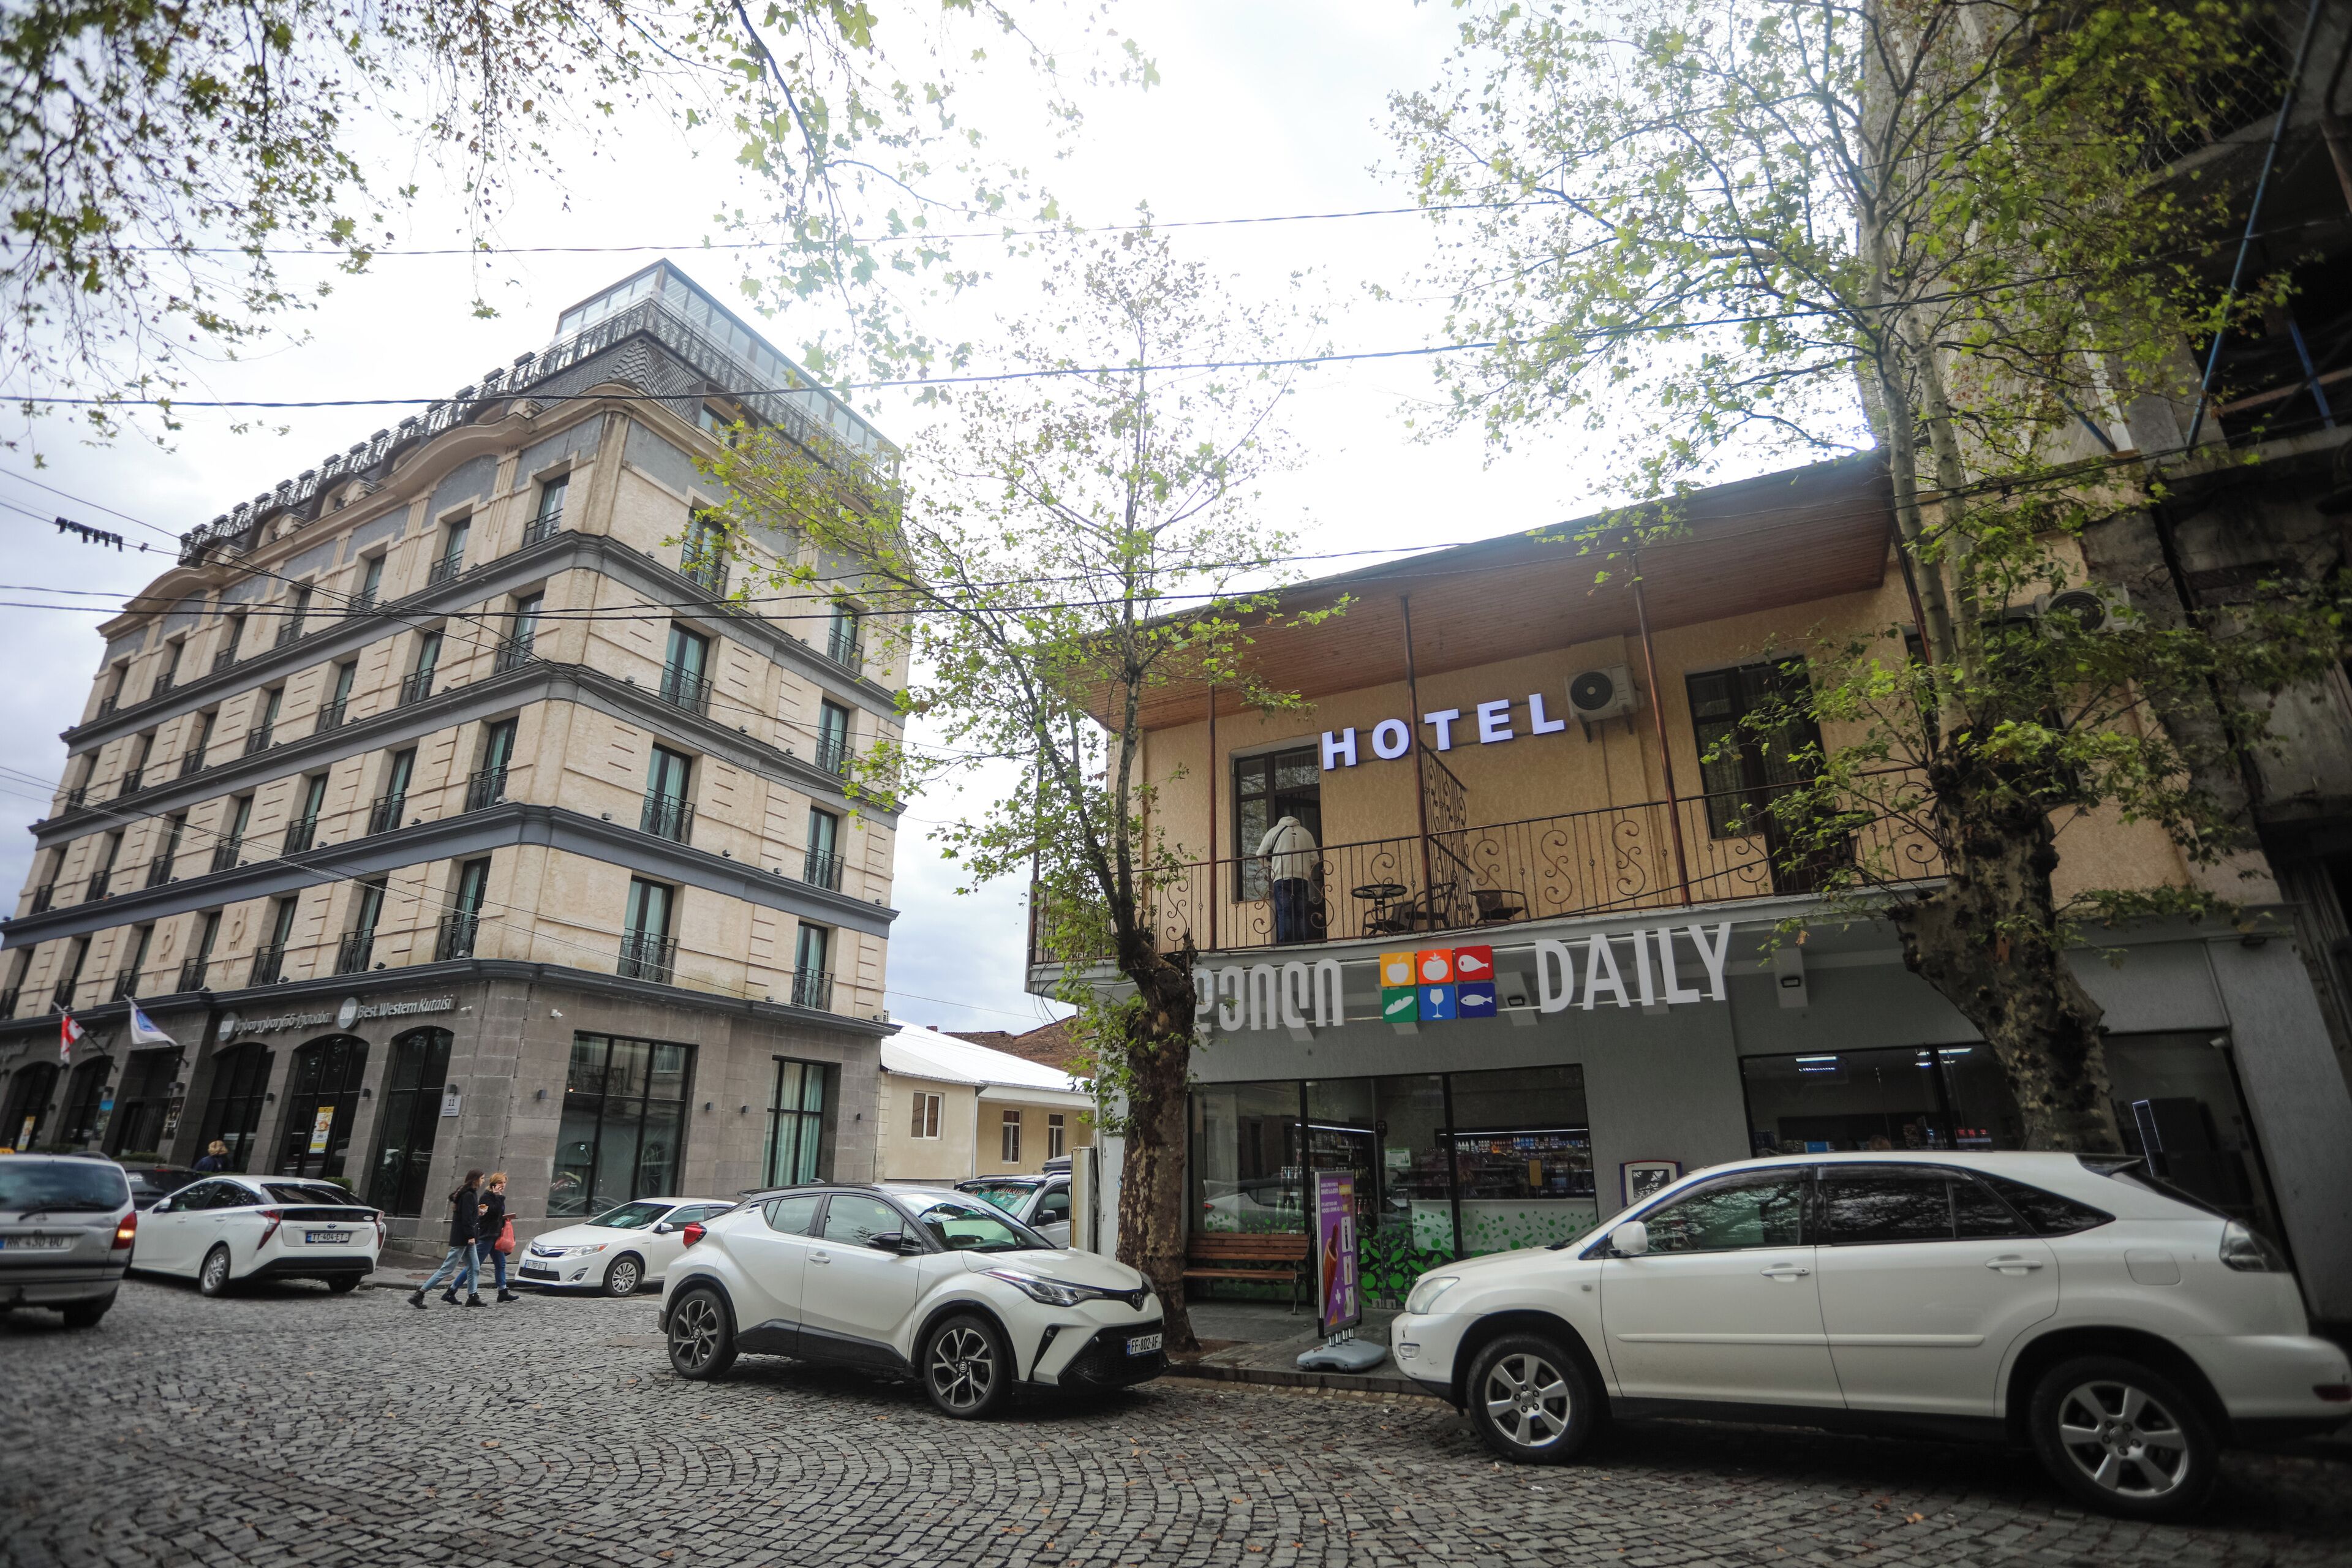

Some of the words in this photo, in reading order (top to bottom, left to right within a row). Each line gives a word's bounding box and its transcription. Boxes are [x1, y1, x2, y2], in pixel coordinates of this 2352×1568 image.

[1321, 693, 1566, 771] HOTEL
[1535, 921, 1732, 1014] DAILY
[358, 1005, 379, 1019] Best
[379, 1001, 418, 1017] Western
[417, 993, 454, 1012] Kutaisi
[1131, 1335, 1158, 1353] FF-802-AF
